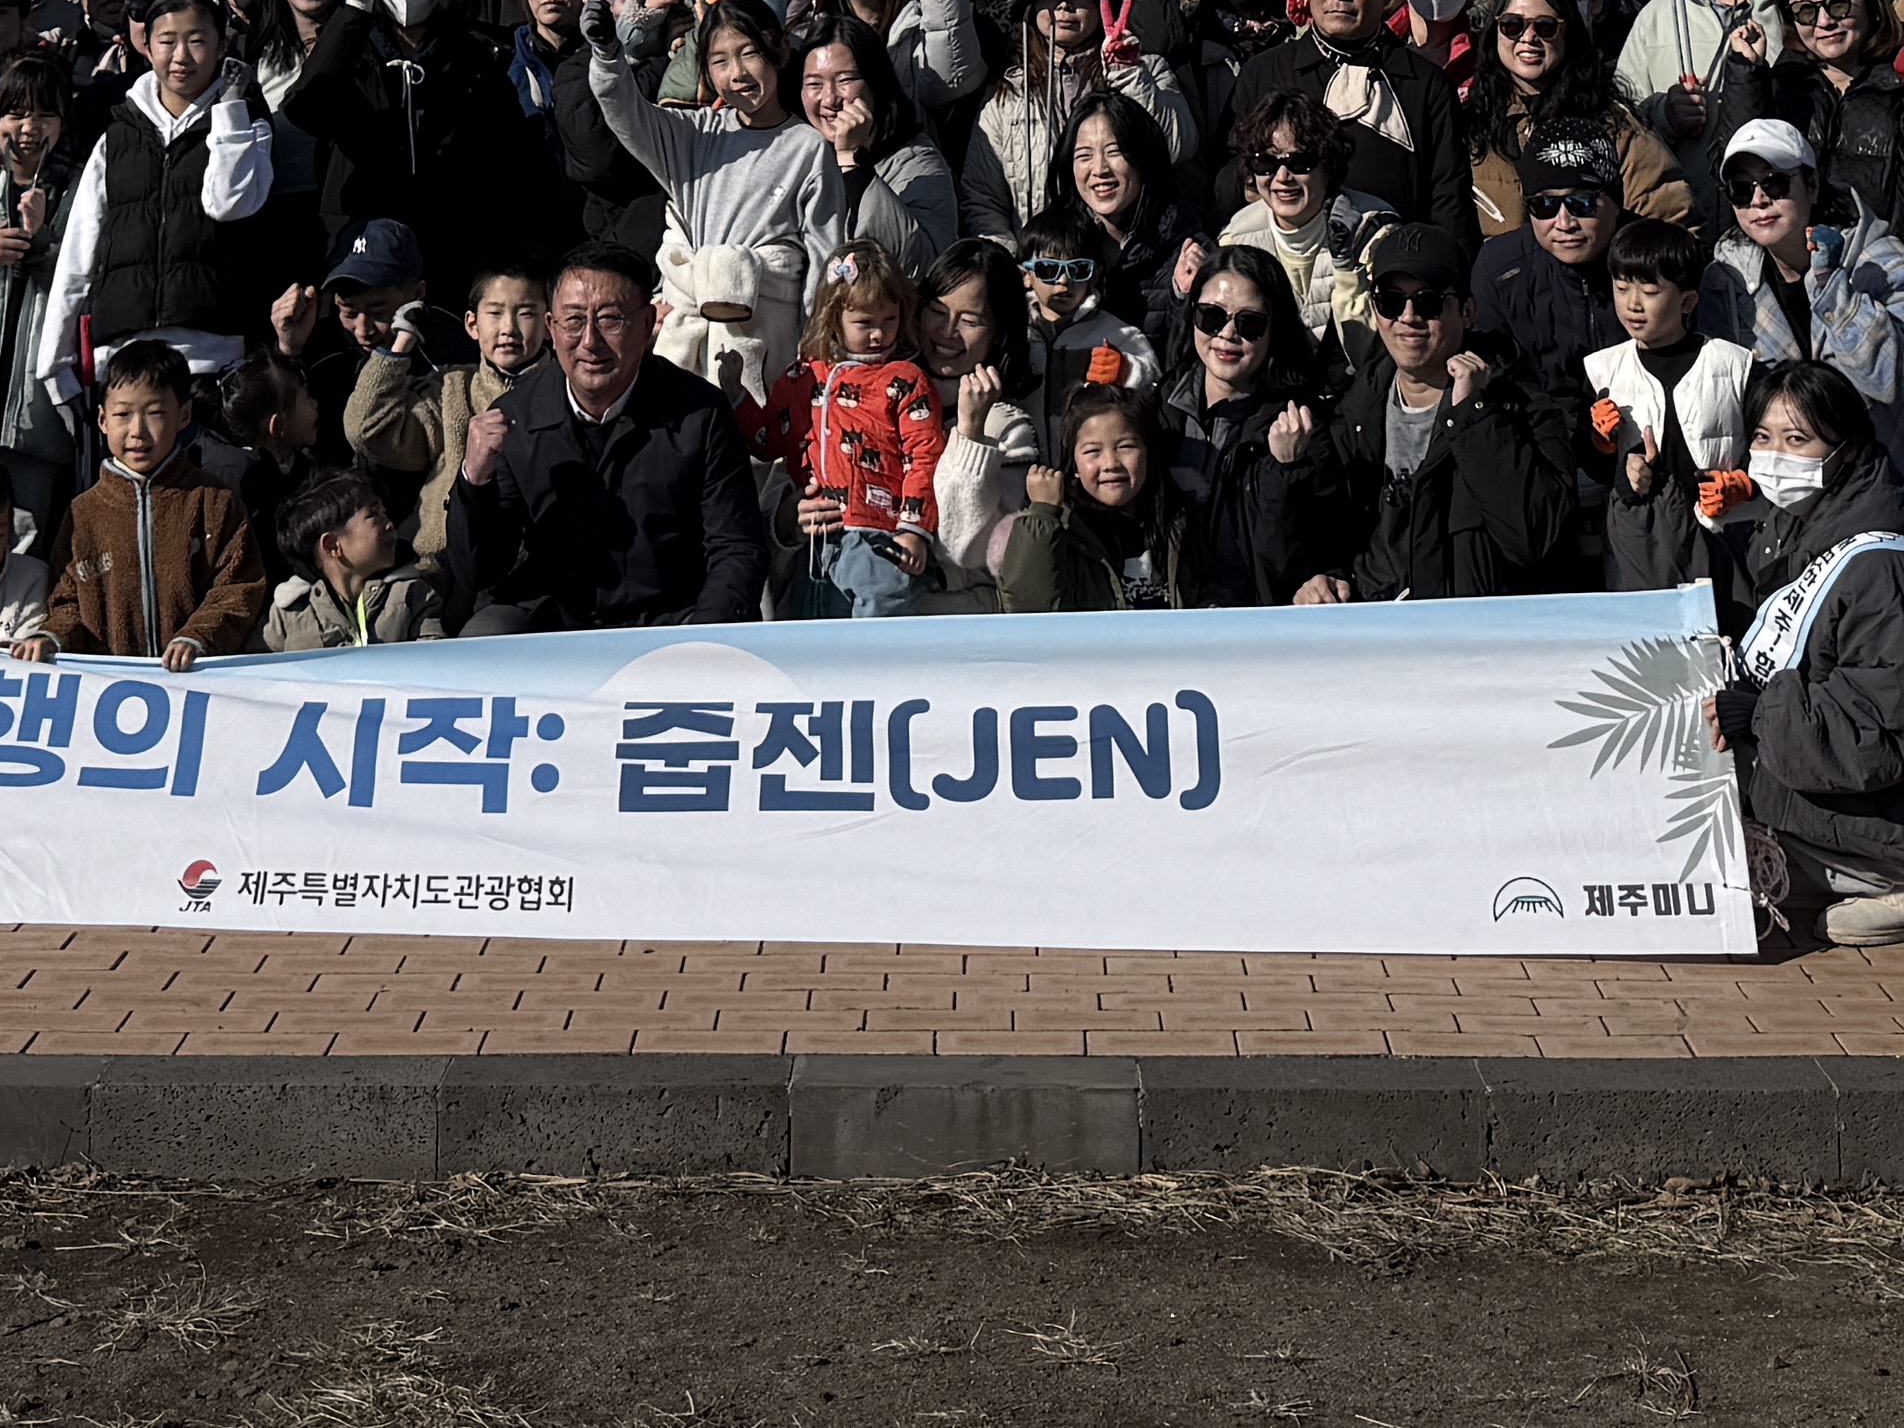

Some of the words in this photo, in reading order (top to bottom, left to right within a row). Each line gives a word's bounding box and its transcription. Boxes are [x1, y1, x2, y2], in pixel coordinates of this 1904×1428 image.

[257, 697, 566, 814] 시작:
[615, 689, 1223, 813] 줍젠(JEN)
[179, 901, 211, 913] JTA
[237, 870, 574, 913] 제주특별자치도관광협회
[1582, 883, 1716, 917] 제주미니
